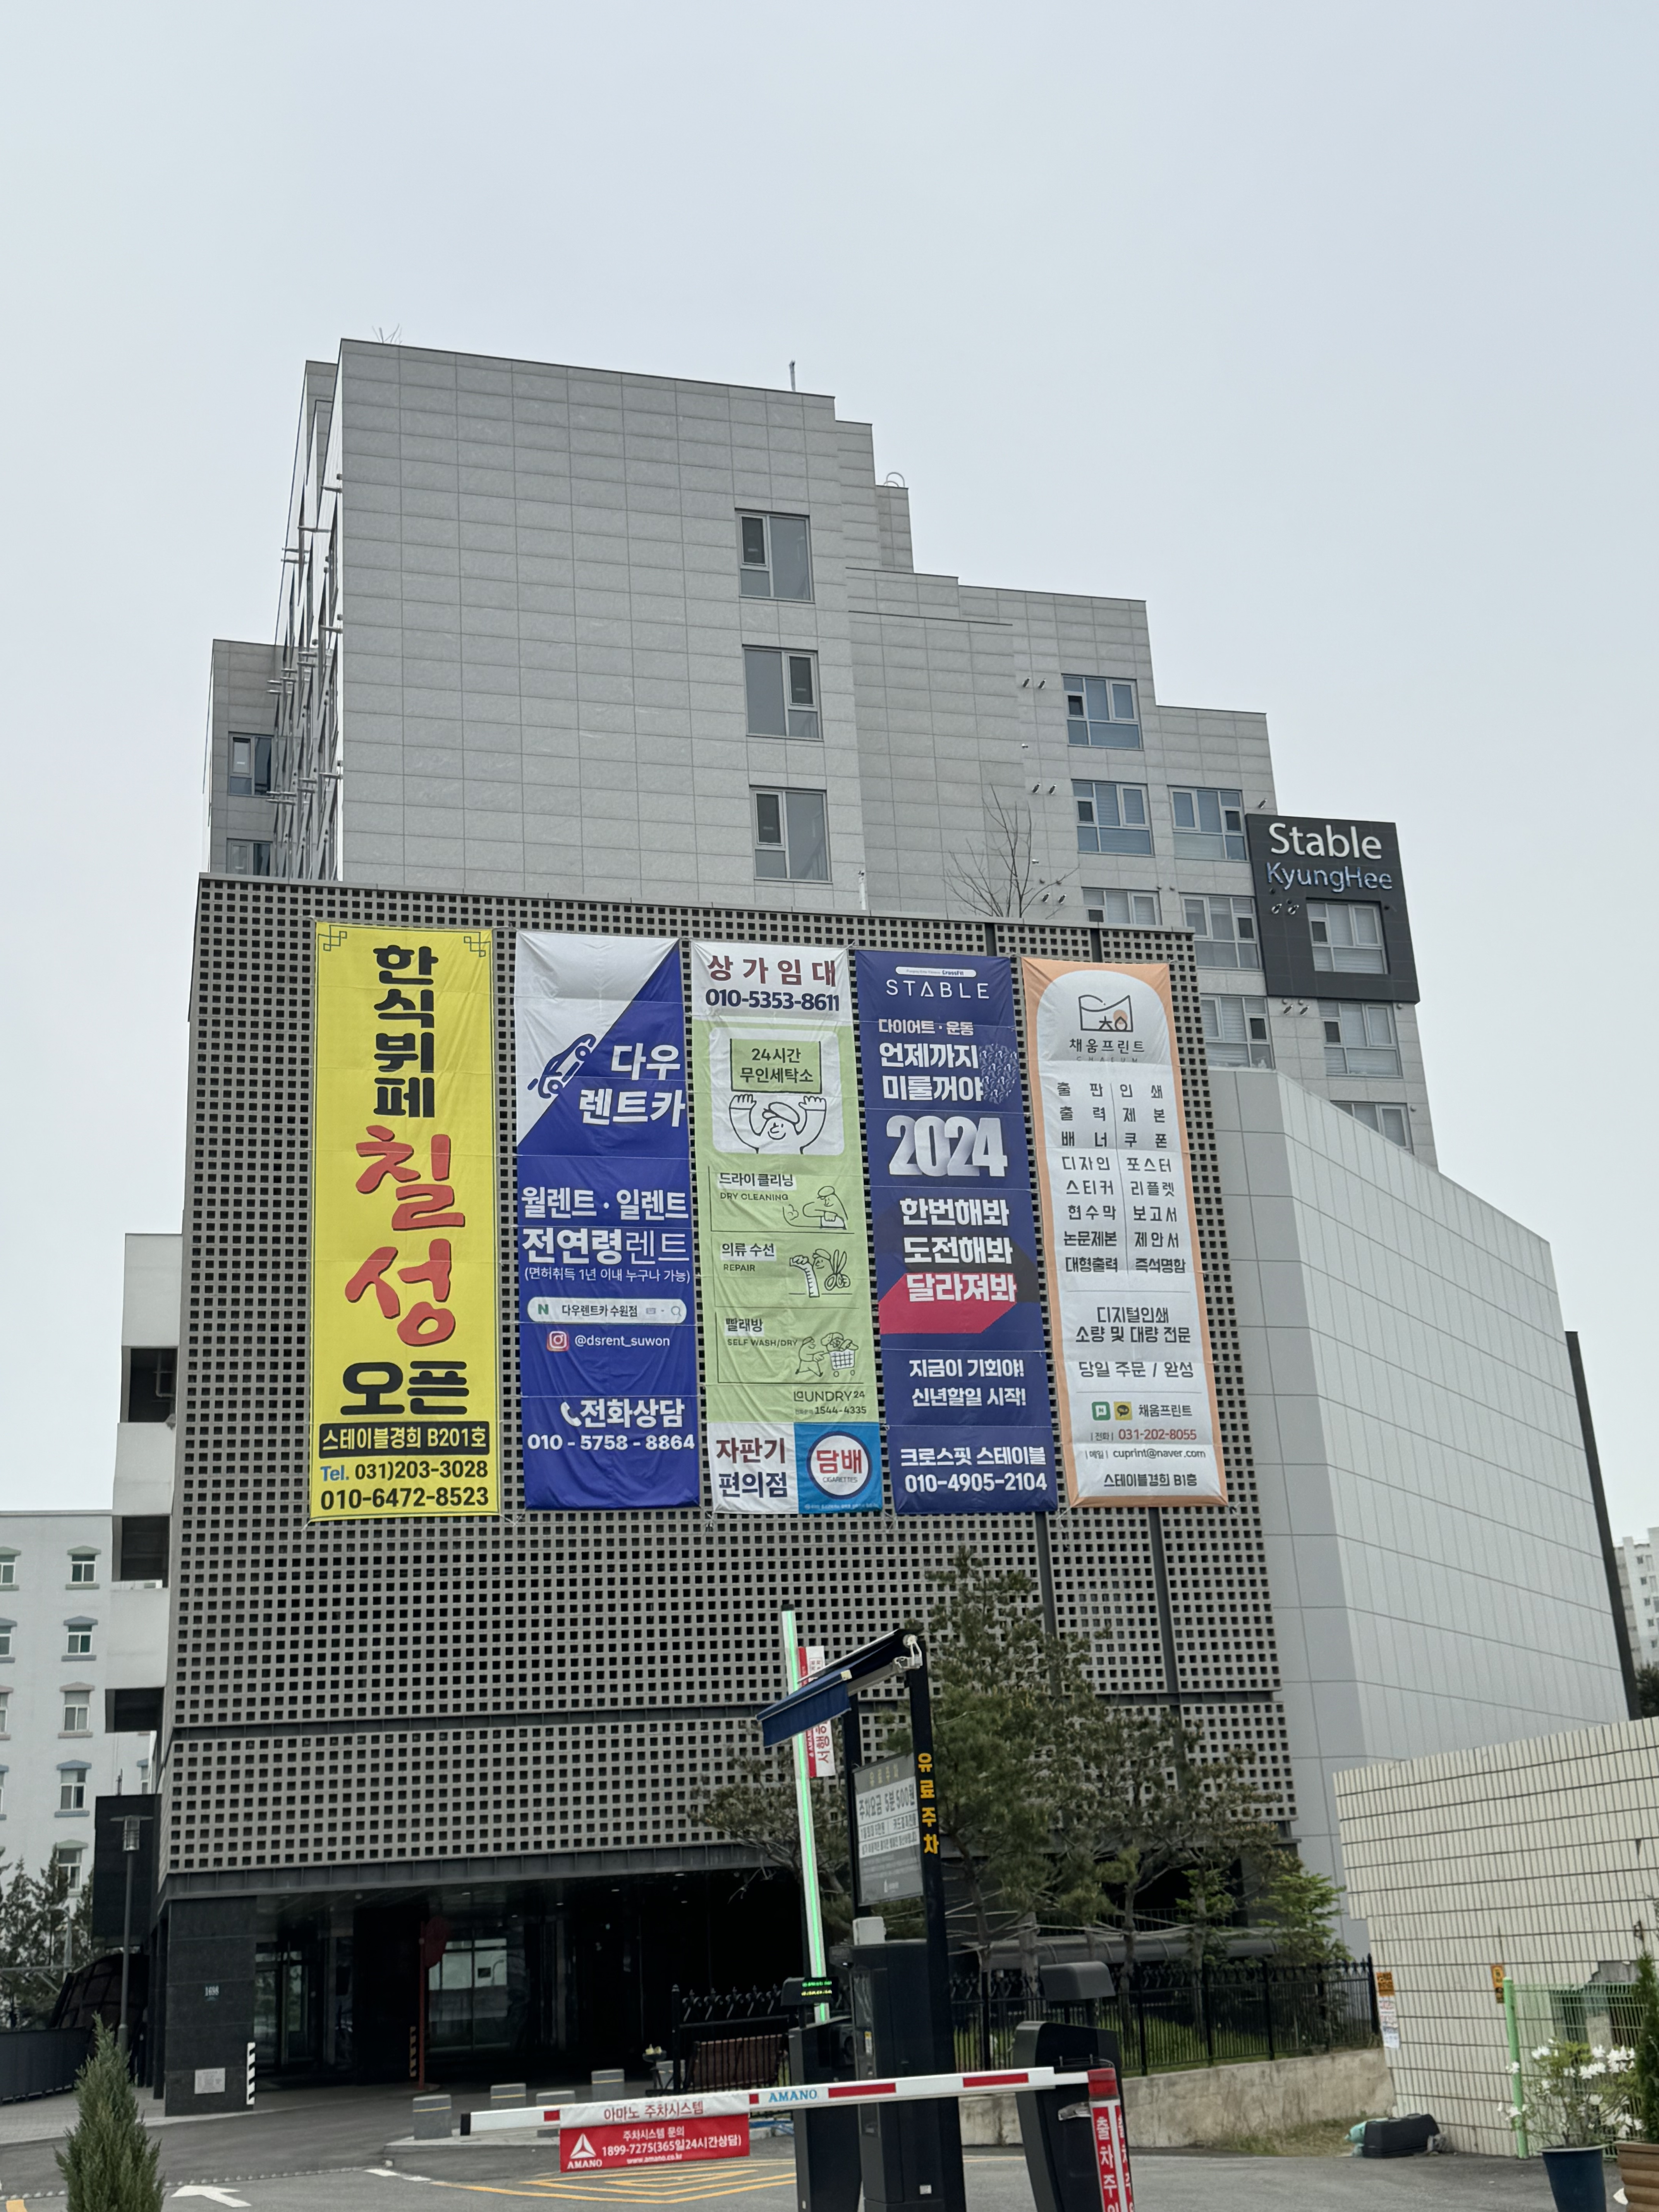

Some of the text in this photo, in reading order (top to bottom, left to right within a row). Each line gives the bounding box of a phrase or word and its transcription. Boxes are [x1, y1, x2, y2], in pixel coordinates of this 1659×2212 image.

[1269, 823, 1382, 859] Stable
[1266, 862, 1393, 892] KyungHee
[886, 979, 989, 999] STABLE
[706, 988, 839, 1012] 010-5353-8611
[373, 945, 438, 1118] 한식뷔페
[879, 1018, 935, 1034] 다이어트
[946, 1021, 974, 1036] 운동
[1069, 1039, 1144, 1054] 채움프린트
[611, 1043, 680, 1080] 다우
[751, 1048, 801, 1063] 24시간
[879, 1042, 979, 1069] 언제까지
[740, 1067, 814, 1083] 무인세탁소
[882, 1075, 984, 1101] 미룰꺼야
[580, 1089, 685, 1127] 렌트카
[886, 1115, 1008, 1176] 2024
[1062, 1156, 1110, 1171] 디자인
[1127, 1158, 1171, 1172] 포스터
[719, 1173, 793, 1187] 드라이 클리닝
[1066, 1180, 1113, 1195] 스티커
[741, 1193, 788, 1201] CLEANING
[1131, 1181, 1174, 1197] 리플렛
[522, 1187, 597, 1218] 월렌트
[617, 1189, 689, 1220] 일렌트
[900, 1198, 1009, 1226] 한번해봐
[1068, 1205, 1116, 1220] 현수막
[1133, 1206, 1177, 1222] 보고서
[345, 1125, 465, 1347] 칠성
[1064, 1231, 1117, 1247] 논문제본
[1134, 1232, 1179, 1248] 제안서
[722, 1242, 775, 1257] 의류 수선
[903, 1237, 1013, 1264] 도전해봐
[1065, 1257, 1118, 1273] 대형출력
[1135, 1257, 1186, 1273] 즉석명함
[524, 1267, 690, 1284] (면허취득 1년 이내 누구나 가능)
[907, 1274, 1017, 1302] 달라져봐
[610, 1305, 638, 1317] 수원점
[1097, 1307, 1169, 1323] 디지털인쇄
[725, 1318, 763, 1332] 빨래방
[575, 1335, 670, 1347] @dsrent_suwon
[1076, 1326, 1190, 1343] 소량 및 대량 전문
[909, 1359, 1024, 1377] 지금이 기회야!
[1079, 1362, 1110, 1377] 당일
[1115, 1362, 1146, 1377] 주문
[1164, 1362, 1194, 1378] 완성
[340, 1361, 469, 1415] 오픈
[912, 1388, 1026, 1407] 신년할일 시작!
[580, 1398, 685, 1428] 전화상담
[814, 1406, 867, 1414] 1544-4335
[1139, 1404, 1192, 1417] 채움프린트
[323, 1426, 486, 1451] 스테이블경희 B201호
[1118, 1429, 1197, 1440] 031-202-8055
[716, 1438, 785, 1464] 자판기
[901, 1446, 1046, 1466] 크로스핏 스테이블
[817, 1449, 862, 1474] 담배
[320, 1460, 488, 1481] Tel. 031)203-3028
[719, 1472, 787, 1498] 편의점
[905, 1473, 1048, 1492] 010-4905-2104
[1104, 1474, 1197, 1487] 스테이블경희 B1층
[321, 1487, 488, 1510] 010-6472-8523
[769, 2090, 817, 2101] AMANO
[604, 2102, 703, 2122] 아마노 주차시스템
[623, 2126, 685, 2141] 주차시스템 문의
[567, 2159, 603, 2169] AMANO
